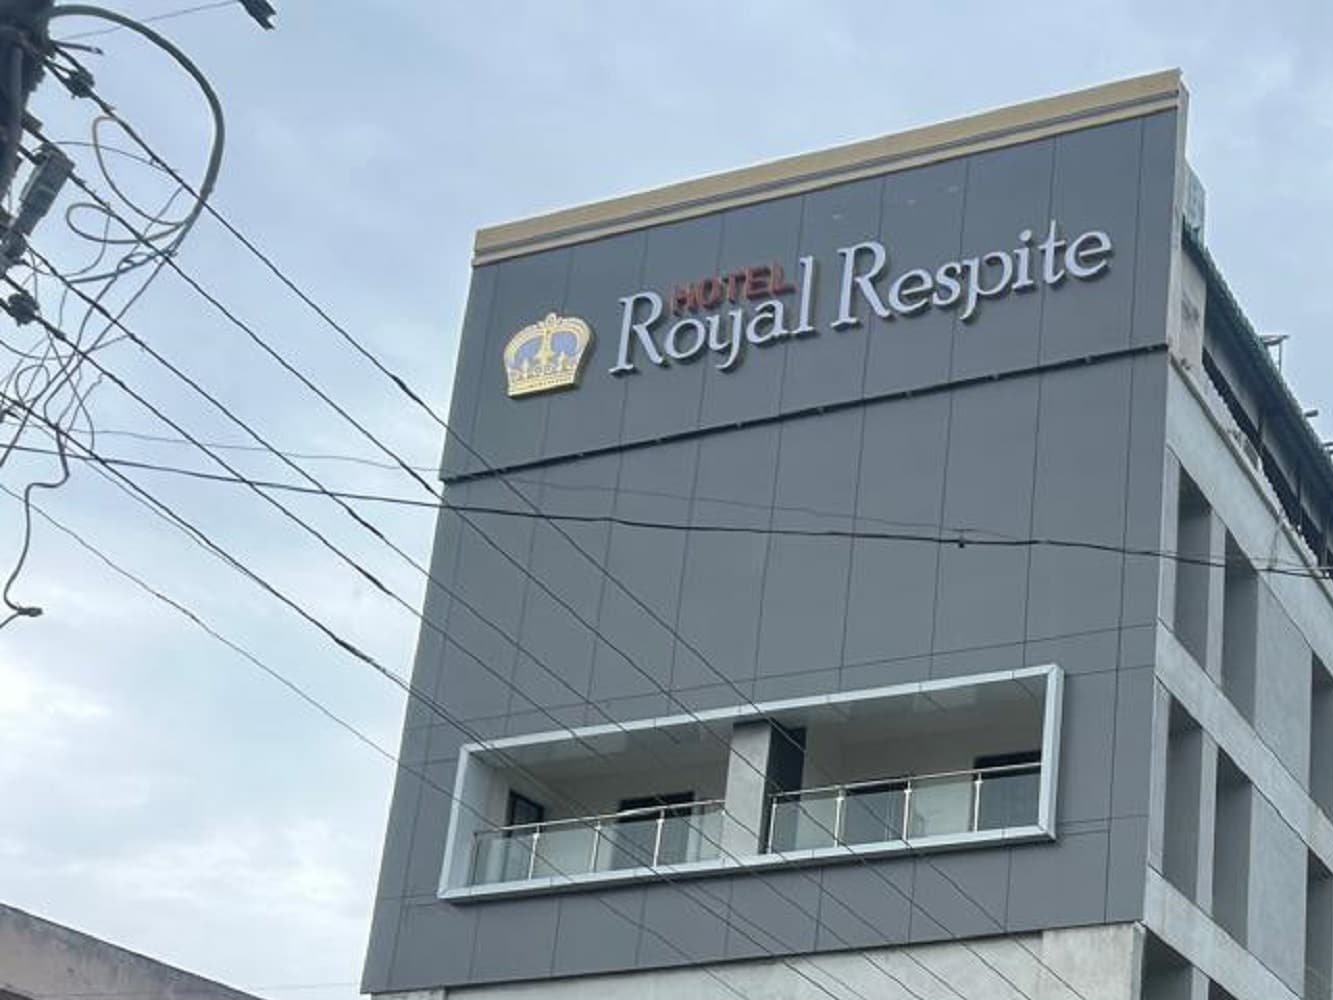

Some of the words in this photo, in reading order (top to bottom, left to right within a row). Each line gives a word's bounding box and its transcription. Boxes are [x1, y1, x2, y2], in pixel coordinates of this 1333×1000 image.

[608, 255, 817, 373] Royal
[830, 219, 1113, 328] Respite
[671, 263, 798, 312] HOTEL
